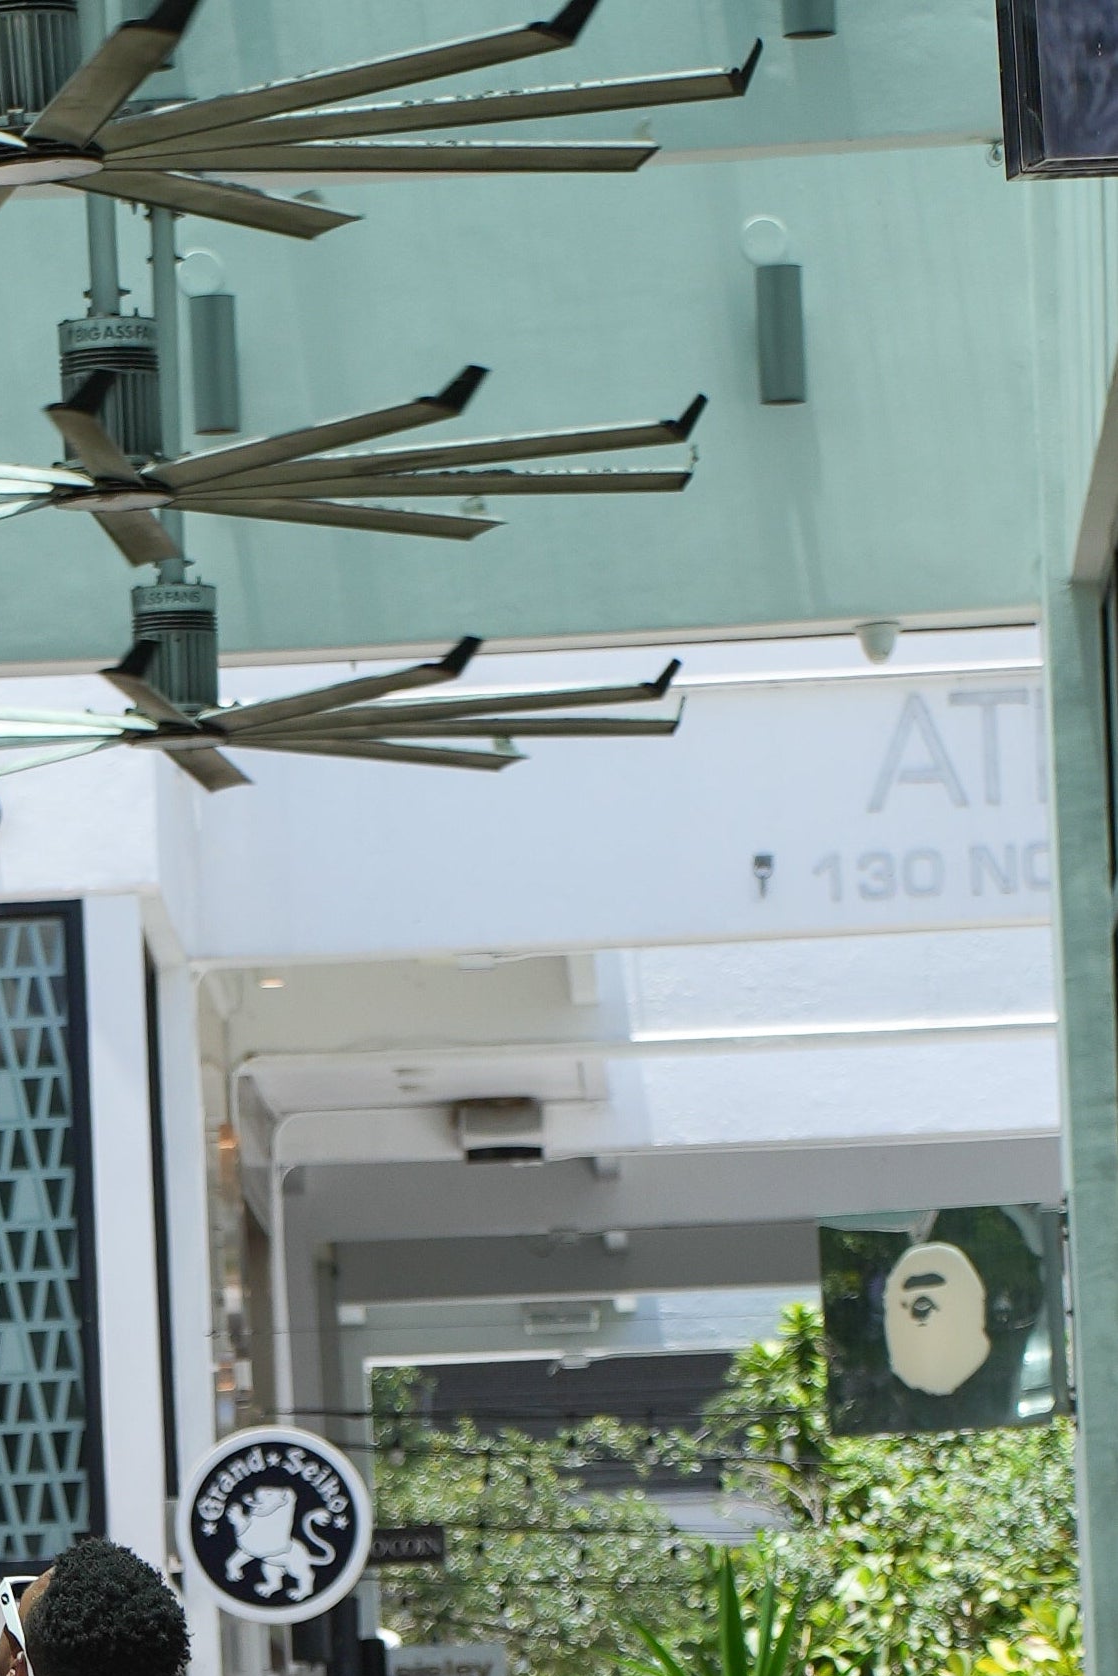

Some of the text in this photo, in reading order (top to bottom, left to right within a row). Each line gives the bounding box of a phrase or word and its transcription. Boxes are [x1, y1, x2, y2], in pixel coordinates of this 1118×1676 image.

[812, 846, 945, 904] 130
[196, 1445, 350, 1522] Grand Seiko
